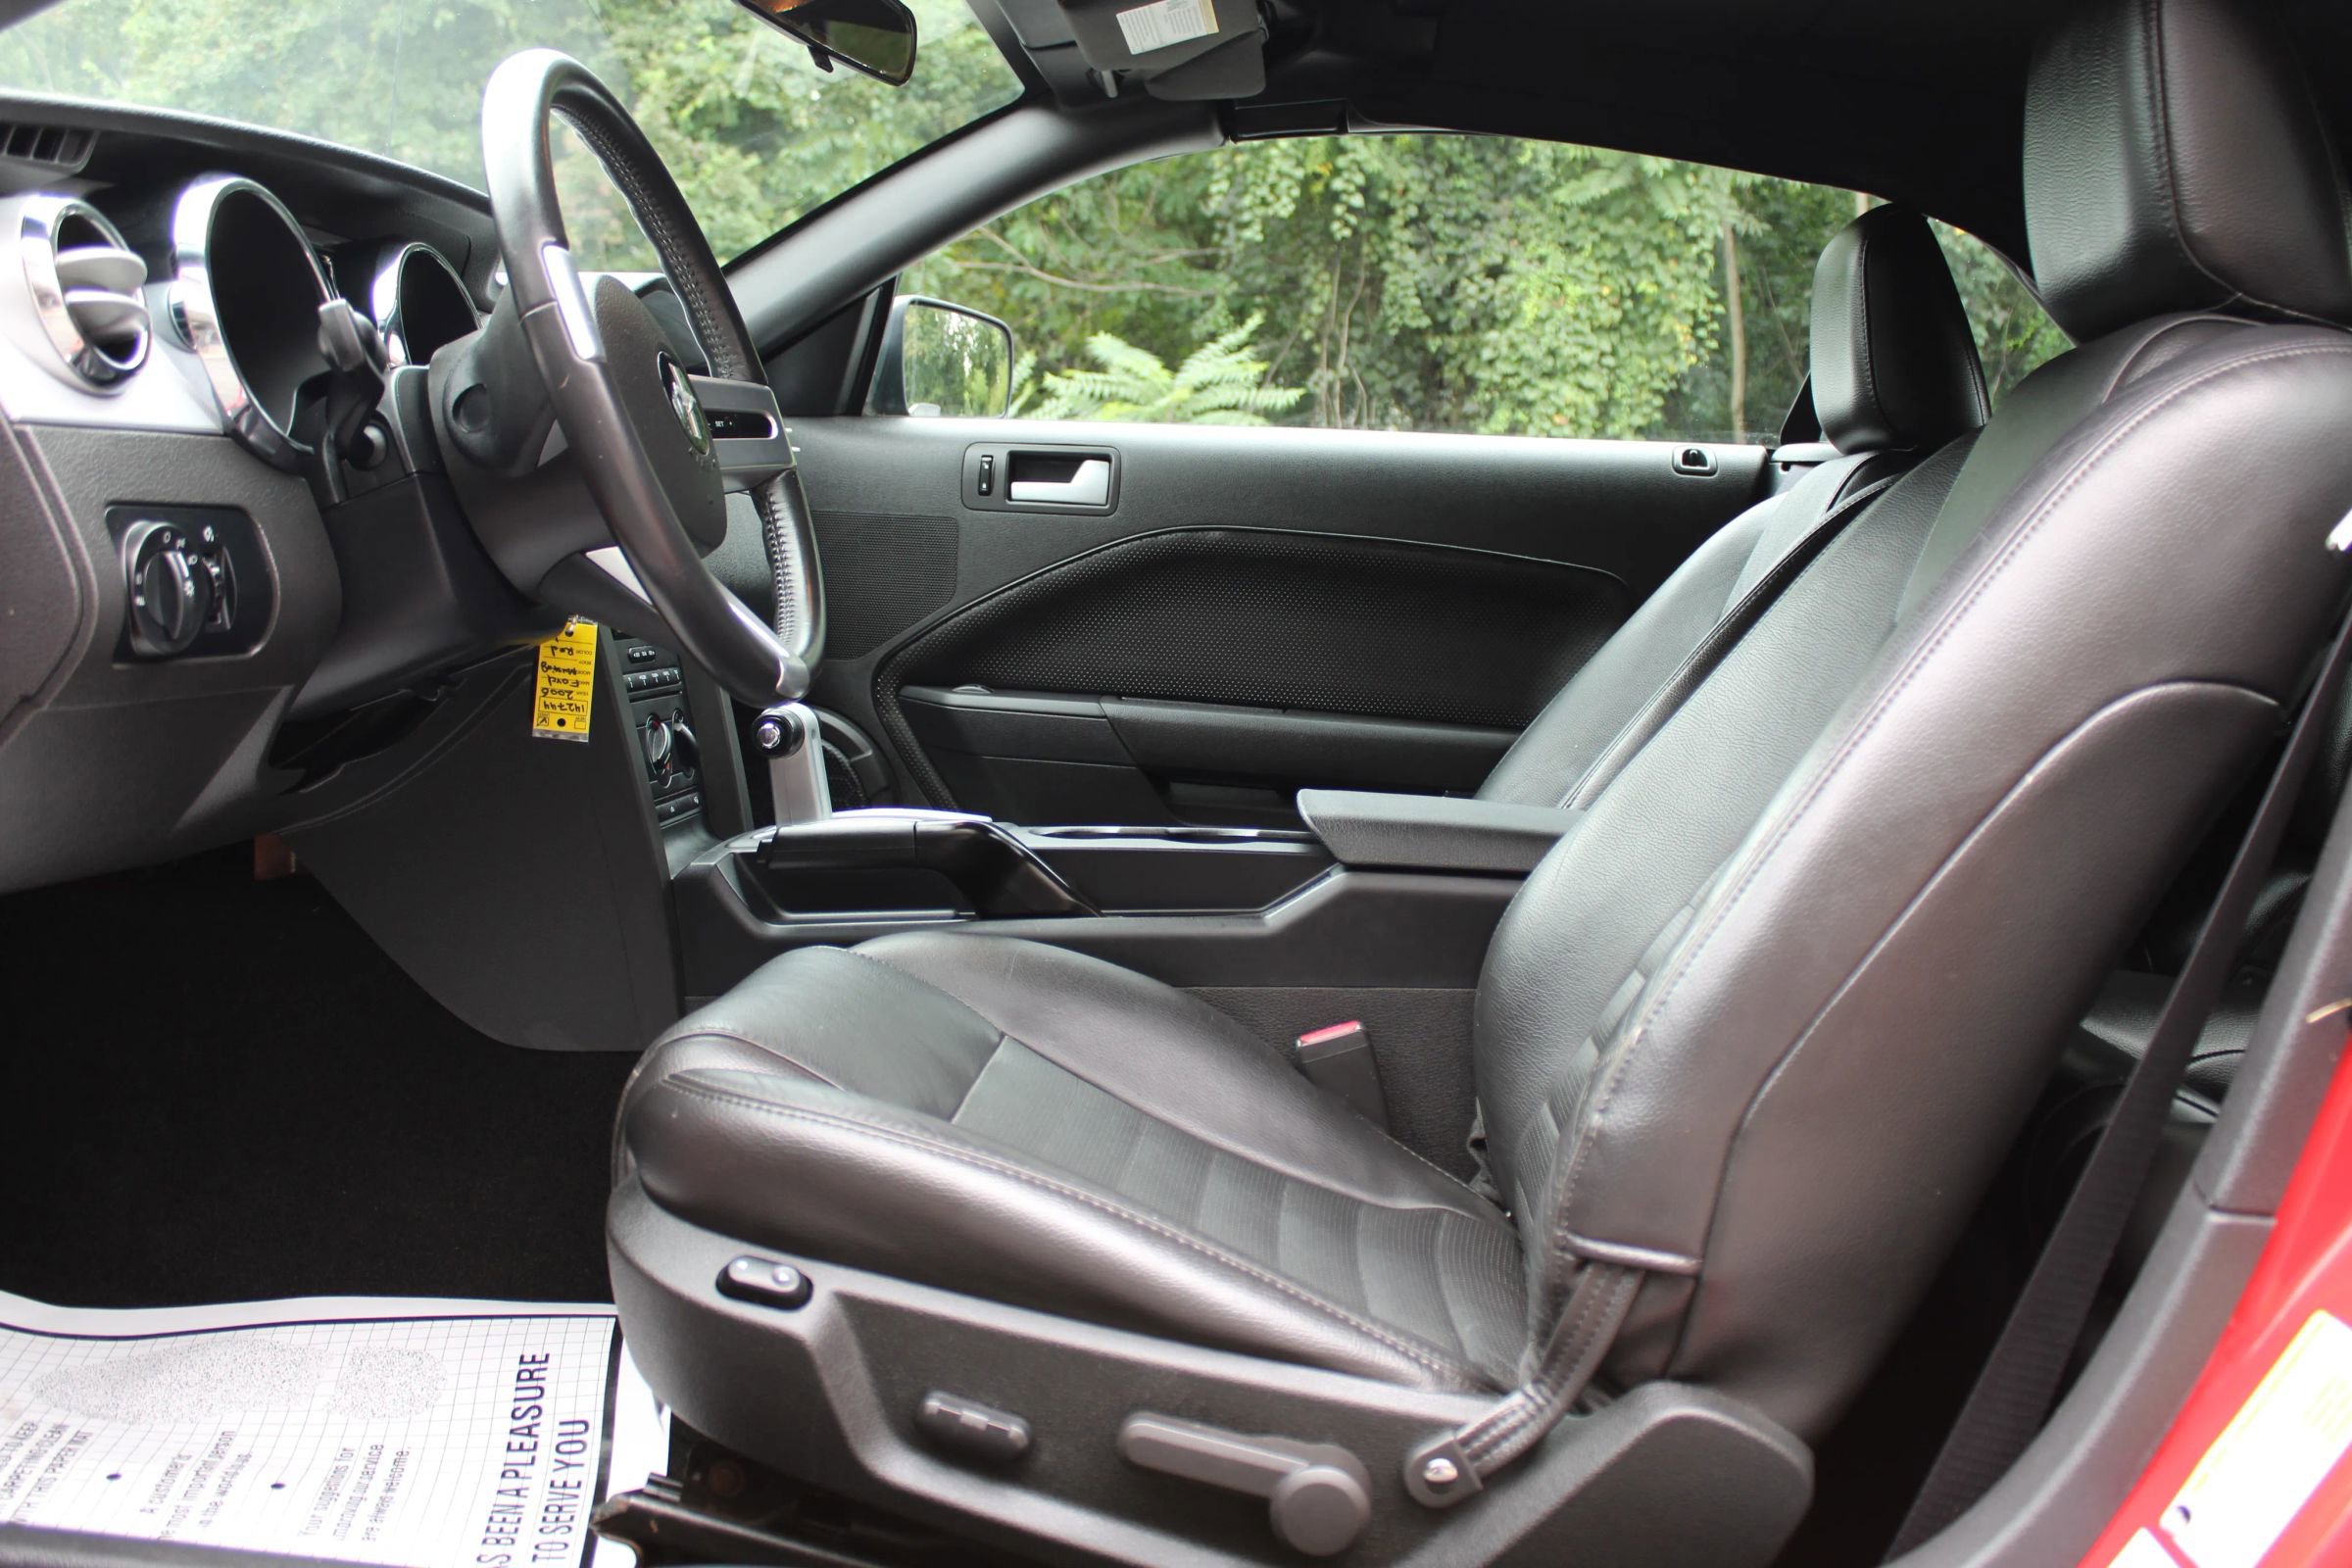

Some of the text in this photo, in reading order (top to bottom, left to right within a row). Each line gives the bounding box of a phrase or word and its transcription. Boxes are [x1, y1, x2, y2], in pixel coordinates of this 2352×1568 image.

[550, 645, 574, 657] Red
[548, 674, 580, 688] Ford
[541, 687, 574, 700] 2006
[476, 1352, 550, 1568] S BEEN A PLEASURE
[531, 1419, 590, 1563] TO SERVE YOU
